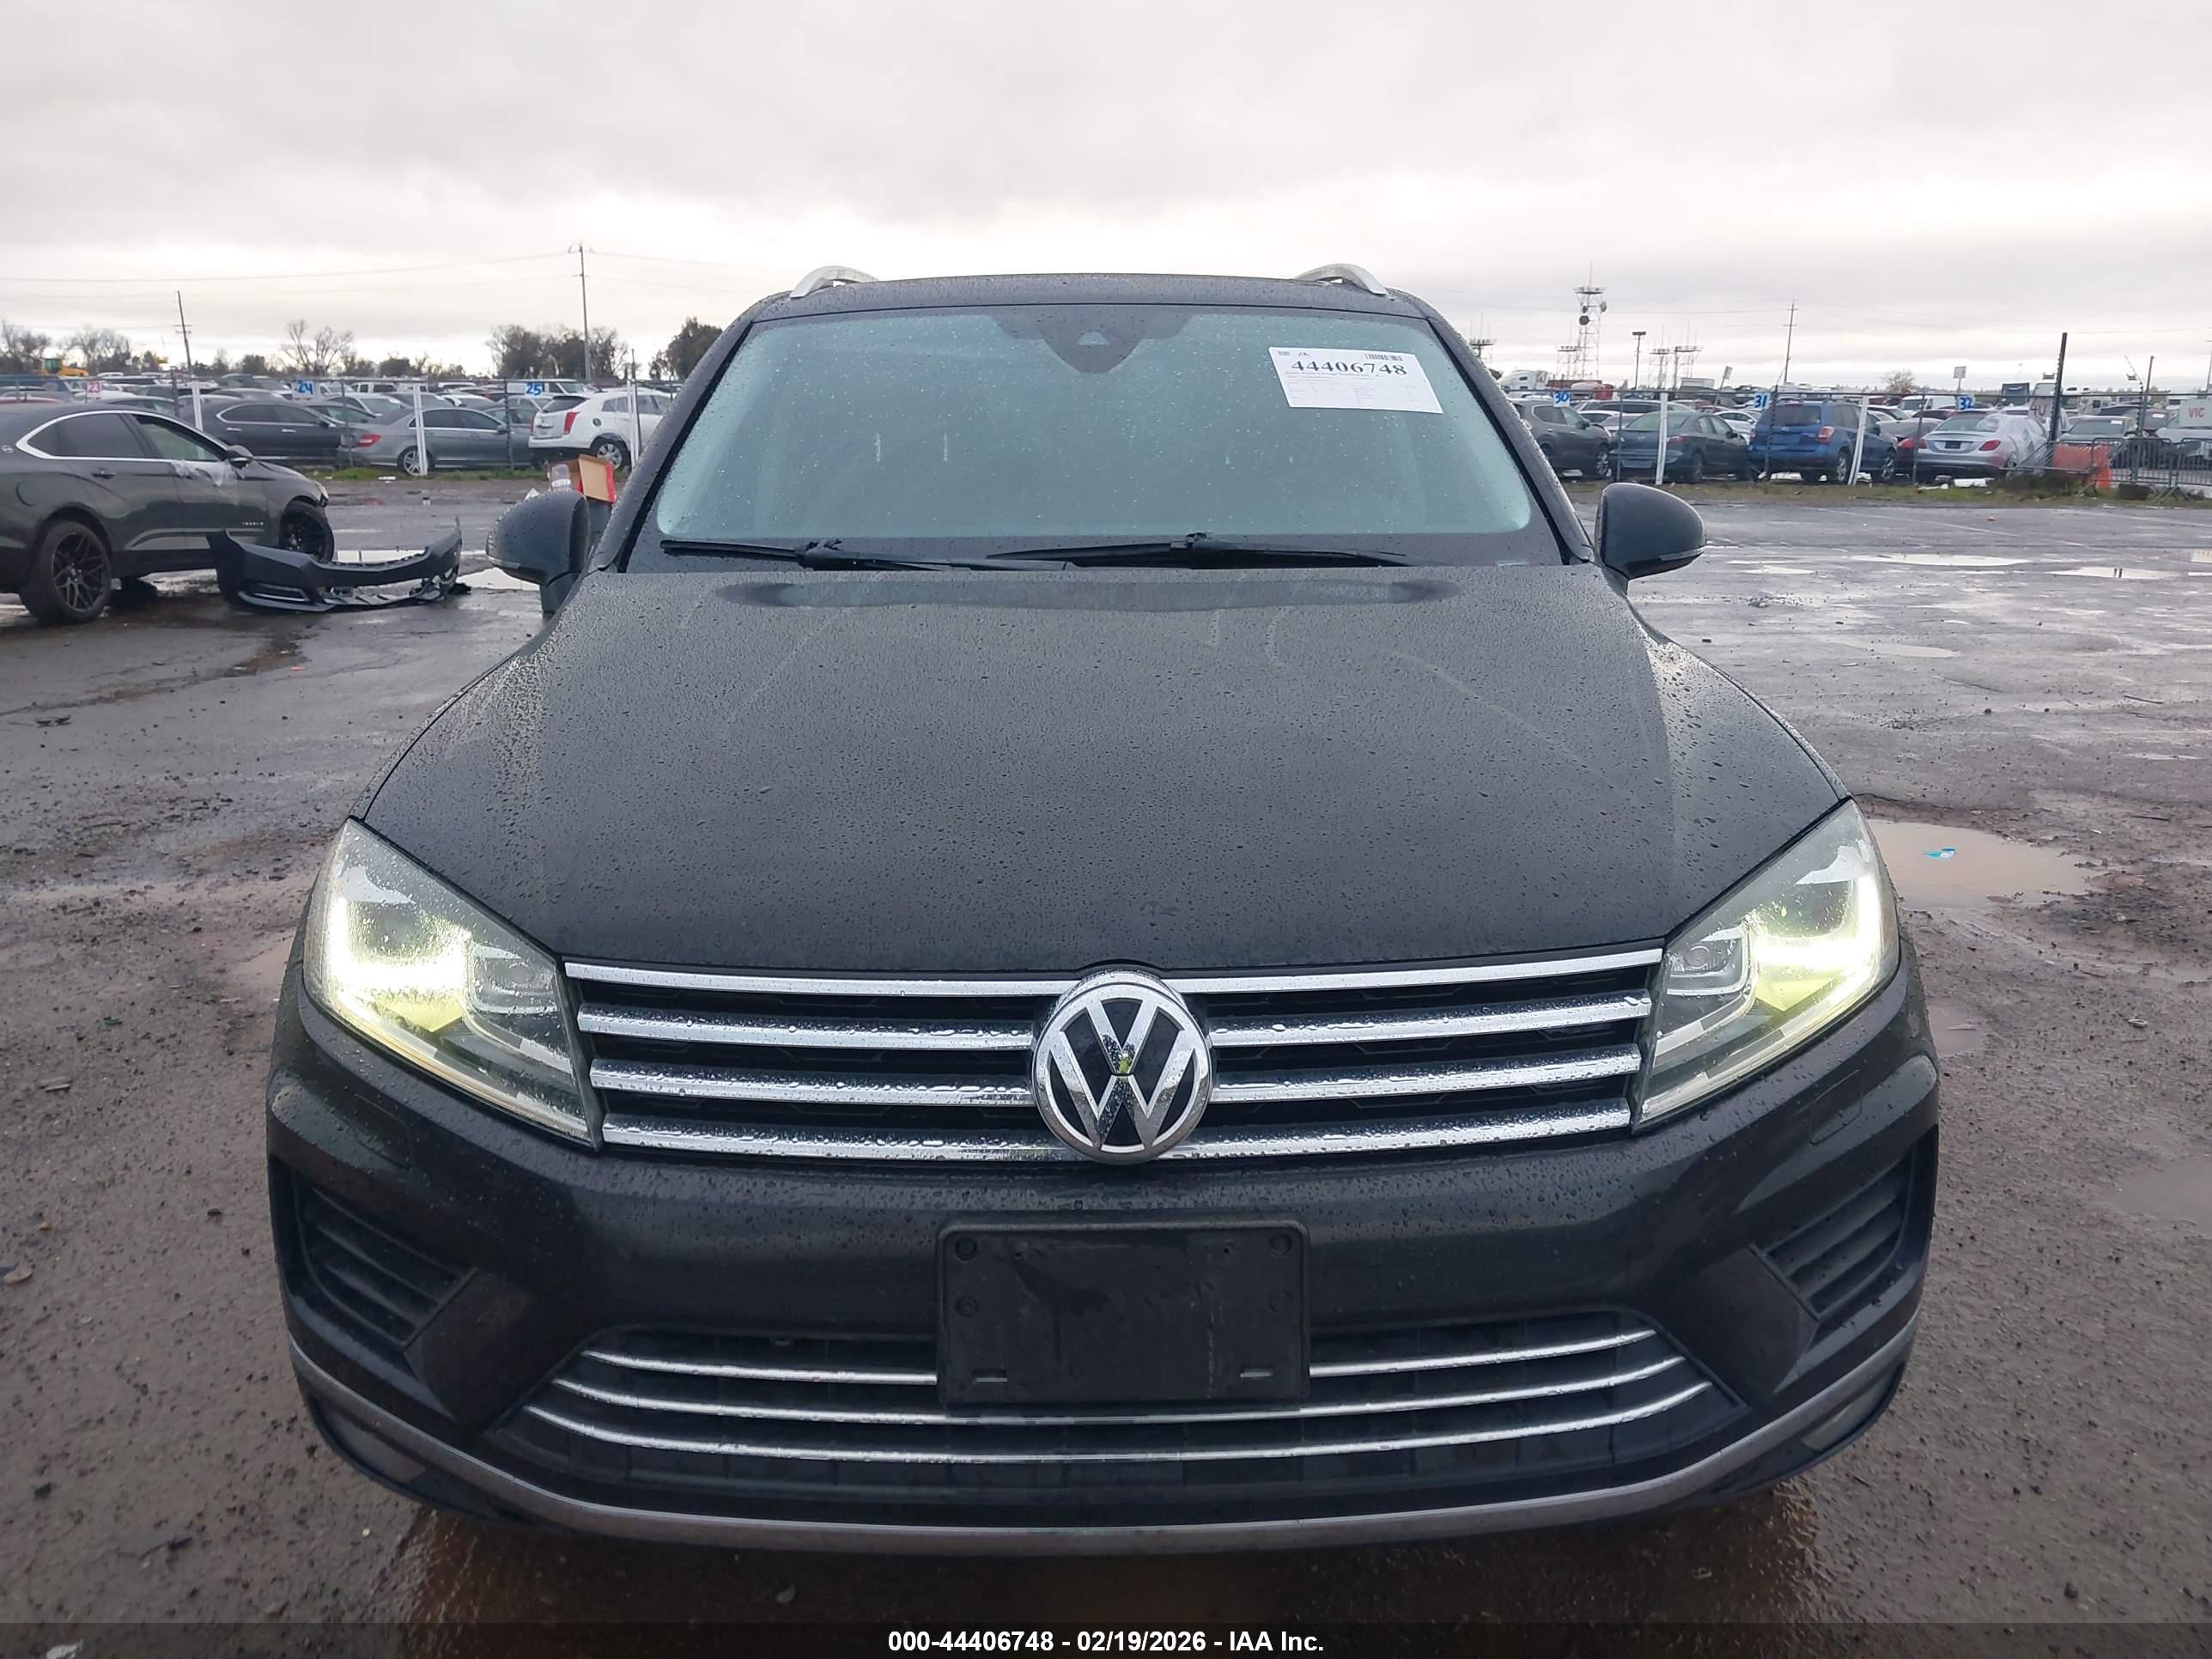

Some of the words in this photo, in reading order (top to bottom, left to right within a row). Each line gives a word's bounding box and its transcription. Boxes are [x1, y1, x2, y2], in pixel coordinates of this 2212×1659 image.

[1291, 360, 1407, 376] 44406748
[88, 381, 100, 393] 23
[297, 380, 313, 395] 24
[526, 381, 542, 396] 25
[1555, 391, 1570, 404] 30
[1754, 395, 1767, 408] 31
[1959, 397, 1974, 410] 32
